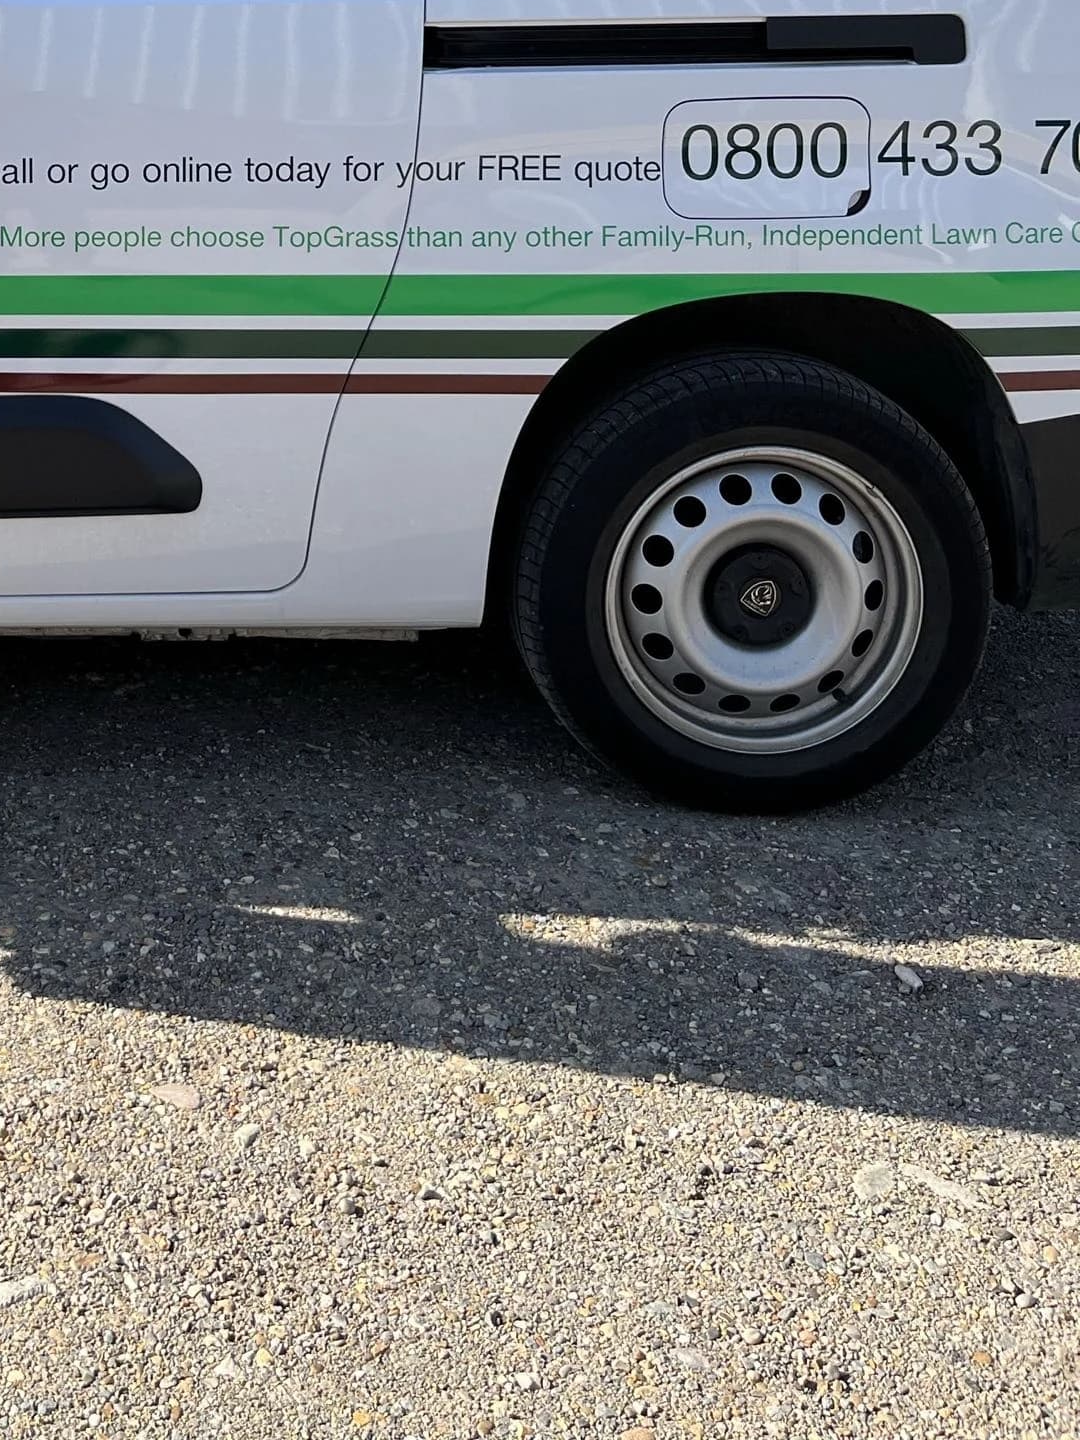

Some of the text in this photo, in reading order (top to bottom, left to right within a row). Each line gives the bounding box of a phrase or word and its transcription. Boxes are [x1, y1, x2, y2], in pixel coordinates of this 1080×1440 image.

[681, 119, 1080, 180] 0800 433 7
[47, 163, 77, 184] or
[90, 163, 129, 190] go
[142, 157, 232, 184] online
[245, 156, 330, 188] today
[343, 156, 384, 182] for
[397, 160, 465, 187] your
[478, 155, 561, 181] FREE
[574, 157, 661, 187] quote
[0, 226, 65, 248] More
[74, 226, 162, 253] people
[170, 226, 265, 248] choose
[272, 226, 399, 253] TopGrass
[407, 226, 463, 247] than
[472, 231, 517, 252] any
[525, 226, 593, 248] other
[602, 225, 752, 252] Family-Run,
[762, 223, 923, 251] Independent
[932, 222, 997, 245] Lawn
[1005, 221, 1063, 244] Care
